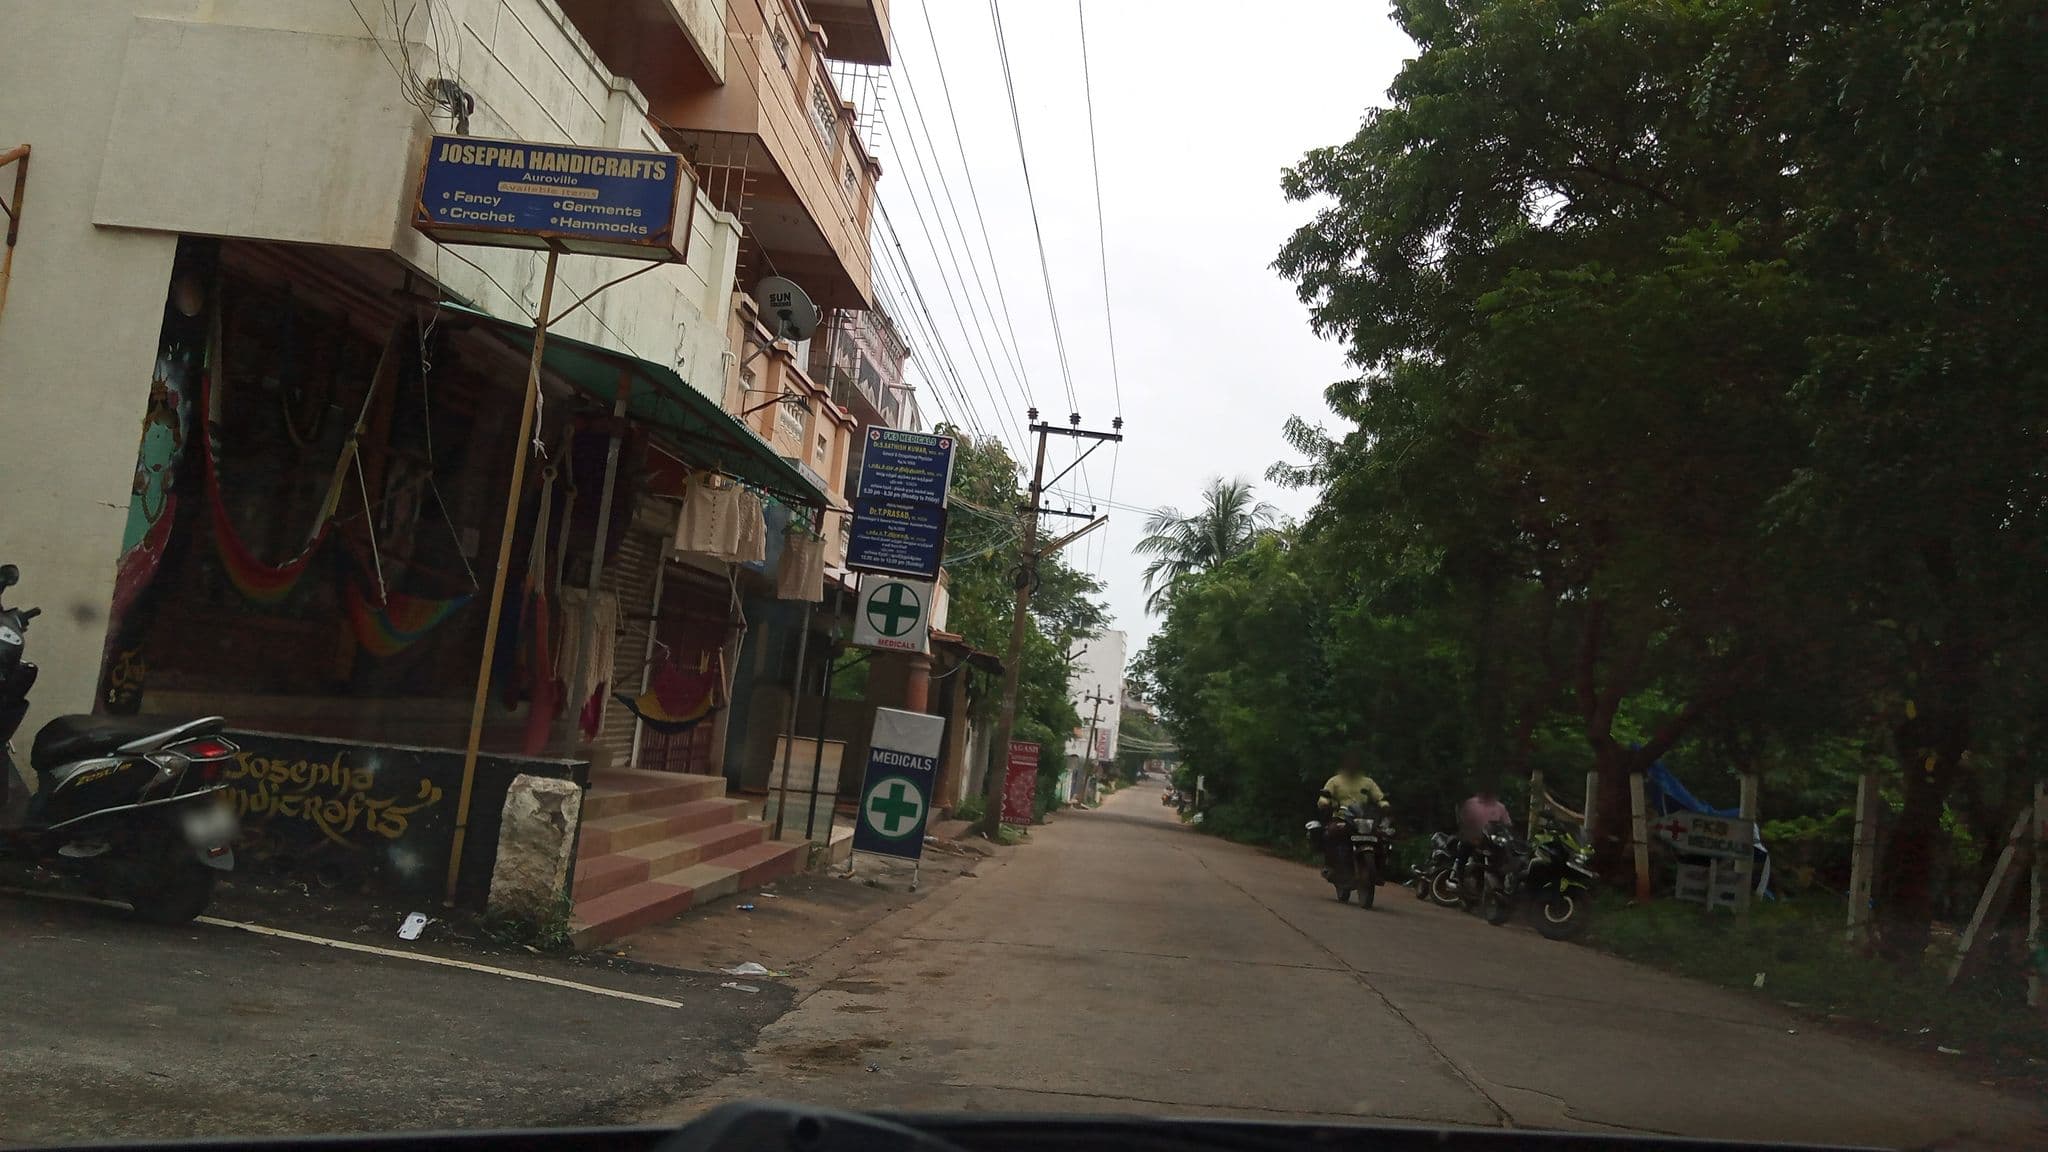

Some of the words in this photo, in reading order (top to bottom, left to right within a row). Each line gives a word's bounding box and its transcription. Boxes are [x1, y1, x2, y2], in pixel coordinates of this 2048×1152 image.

[438, 143, 525, 169] JOSEPHA
[529, 151, 667, 181] HANDICRAFTS
[522, 173, 579, 186] Auroville
[454, 191, 502, 207] Fancy
[450, 207, 516, 223] Crochet
[562, 200, 643, 217] Garments
[560, 217, 648, 235] Hammocks
[769, 291, 792, 303] SUN
[878, 638, 916, 650] MEDICALS
[872, 750, 932, 771] MEDICALS
[223, 751, 375, 796] Josepha
